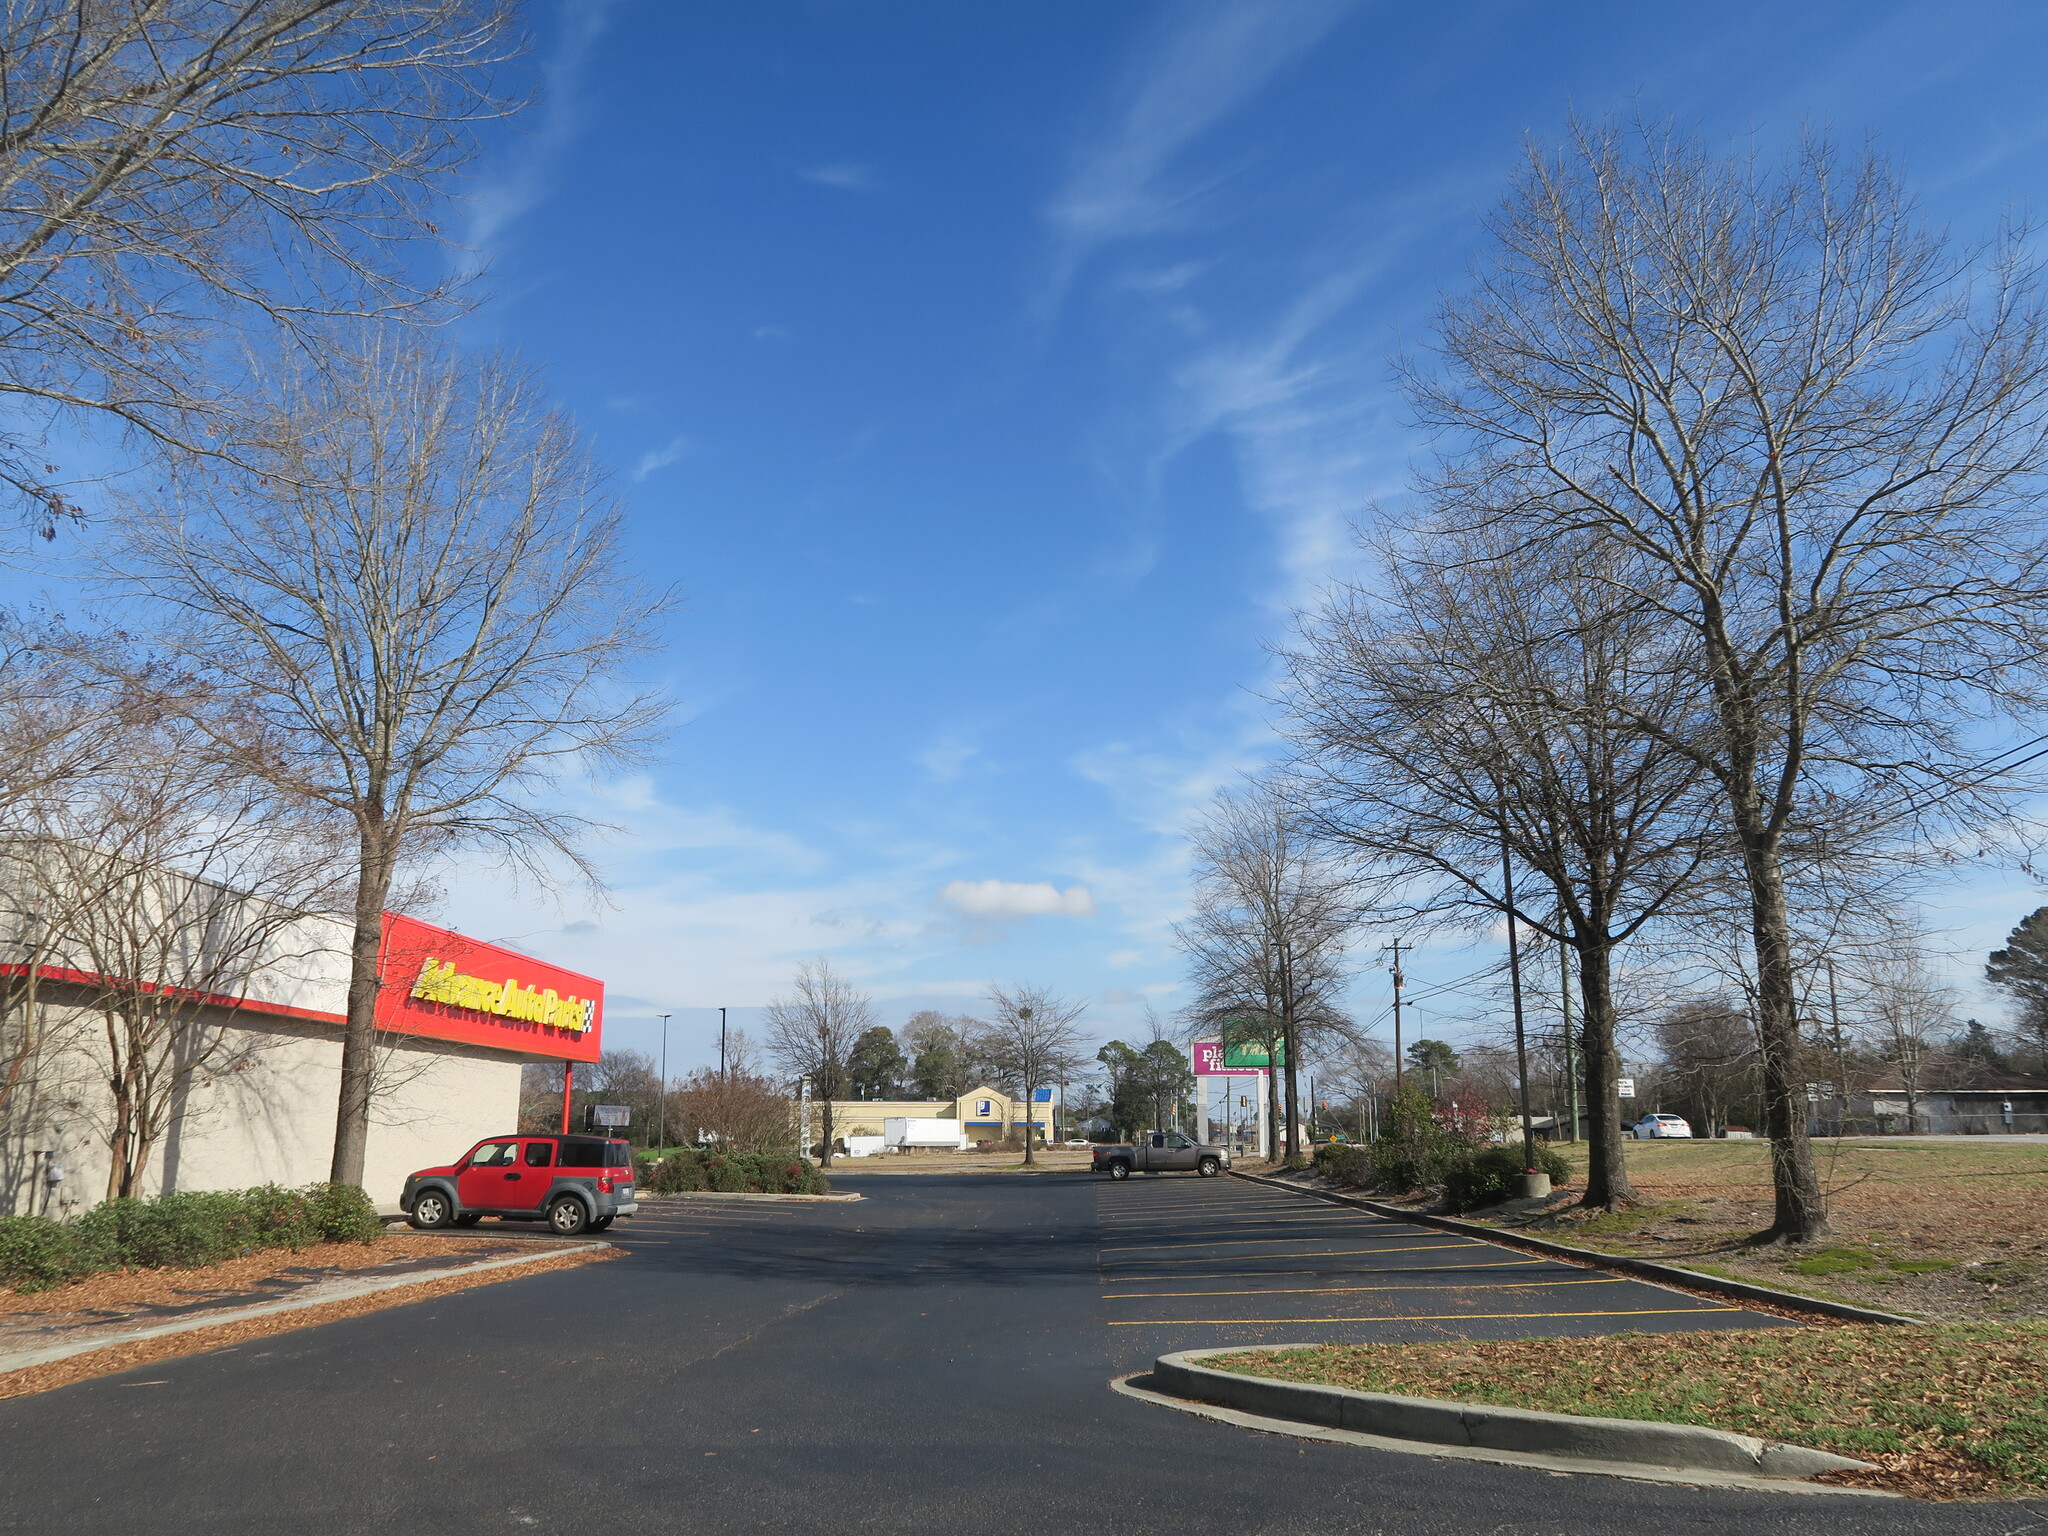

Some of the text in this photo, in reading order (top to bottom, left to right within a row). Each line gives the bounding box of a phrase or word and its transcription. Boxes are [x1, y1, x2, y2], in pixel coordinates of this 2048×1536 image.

[410, 957, 587, 1033] Advance Auto Parts
[1202, 1046, 1224, 1062] pla
